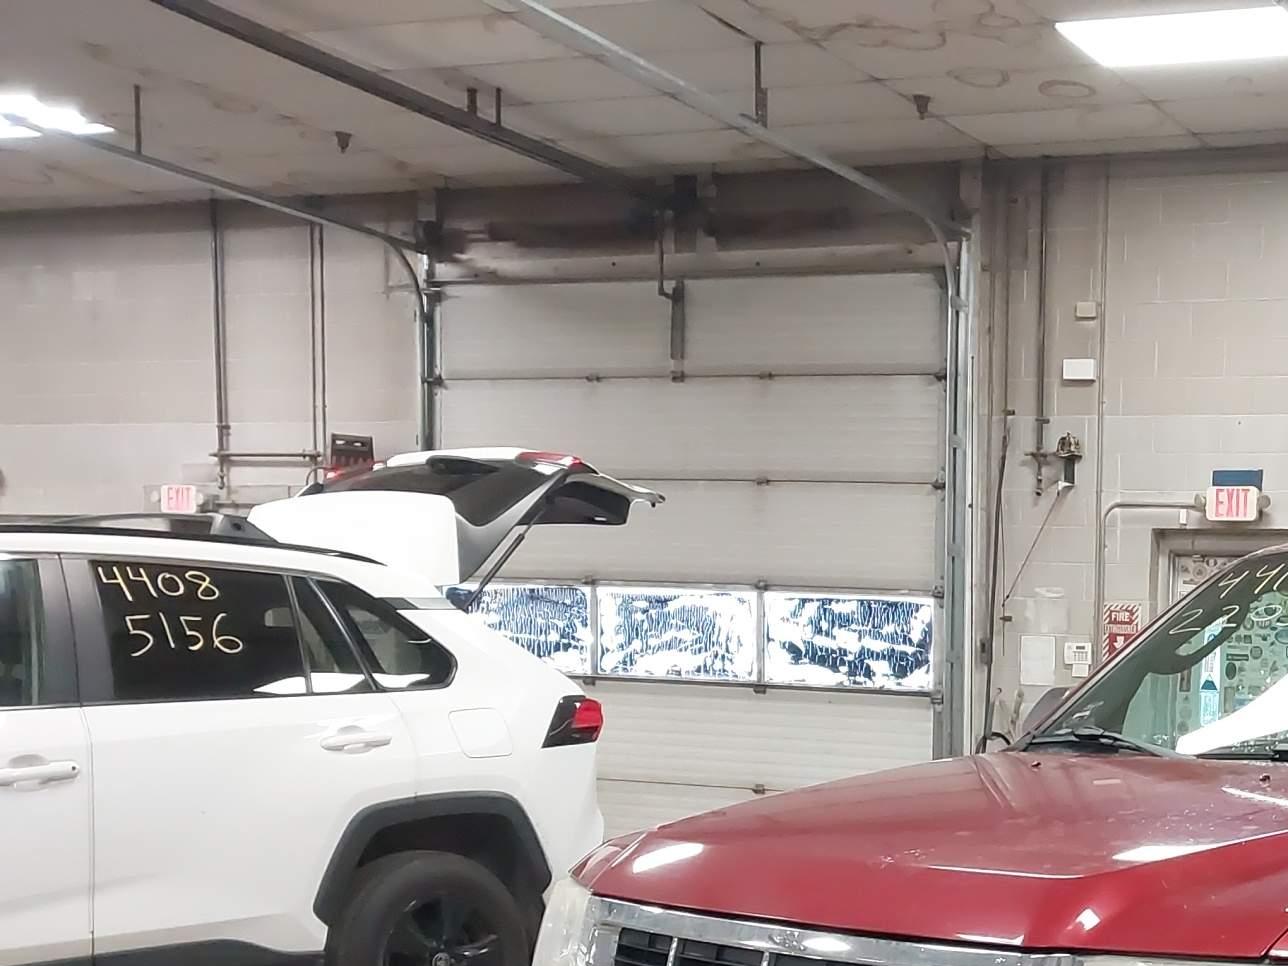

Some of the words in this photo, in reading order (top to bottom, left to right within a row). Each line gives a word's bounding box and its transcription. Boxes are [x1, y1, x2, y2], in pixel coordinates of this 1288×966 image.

[166, 486, 192, 511] EXIT
[1215, 487, 1251, 518] EXIT
[97, 565, 220, 602] 4408
[1110, 611, 1131, 622] FIRE
[124, 611, 244, 657] 5156
